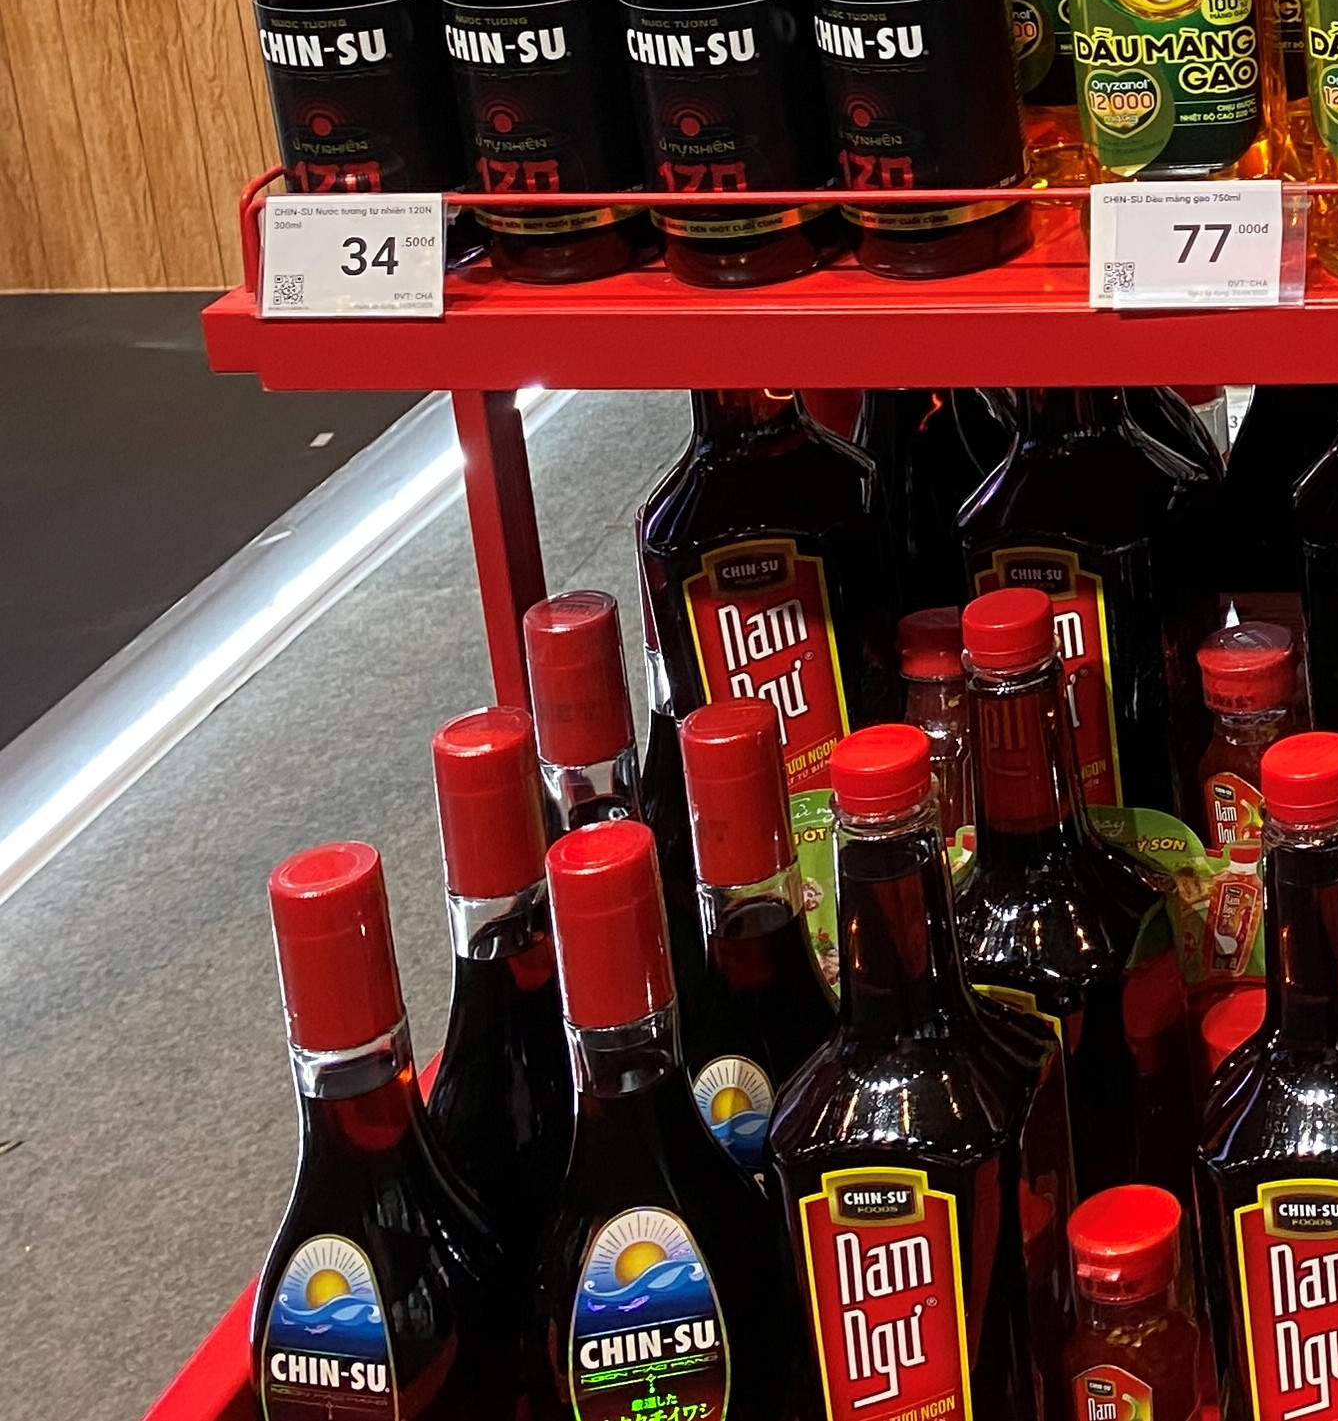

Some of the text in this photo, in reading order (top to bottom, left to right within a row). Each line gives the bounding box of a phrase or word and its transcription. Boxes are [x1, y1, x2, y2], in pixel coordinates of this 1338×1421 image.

[261, 28, 388, 68] CHIN-SU
[445, 26, 567, 64] CHIN-SU
[815, 17, 924, 61] CHIN-SU
[1074, 27, 1138, 64] DẦU
[1179, 59, 1259, 93] GẠO
[1213, 193, 1241, 202] 750ml
[341, 237, 398, 275] 34
[1173, 224, 1232, 263] 77
[721, 559, 780, 578] CHIN-SU
[719, 598, 808, 670] Nam
[844, 1191, 909, 1206] CHIN-SU
[836, 1233, 931, 1304] Nam
[580, 1321, 718, 1369] CHIN-SU
[270, 1354, 388, 1391] CHIN-SU
